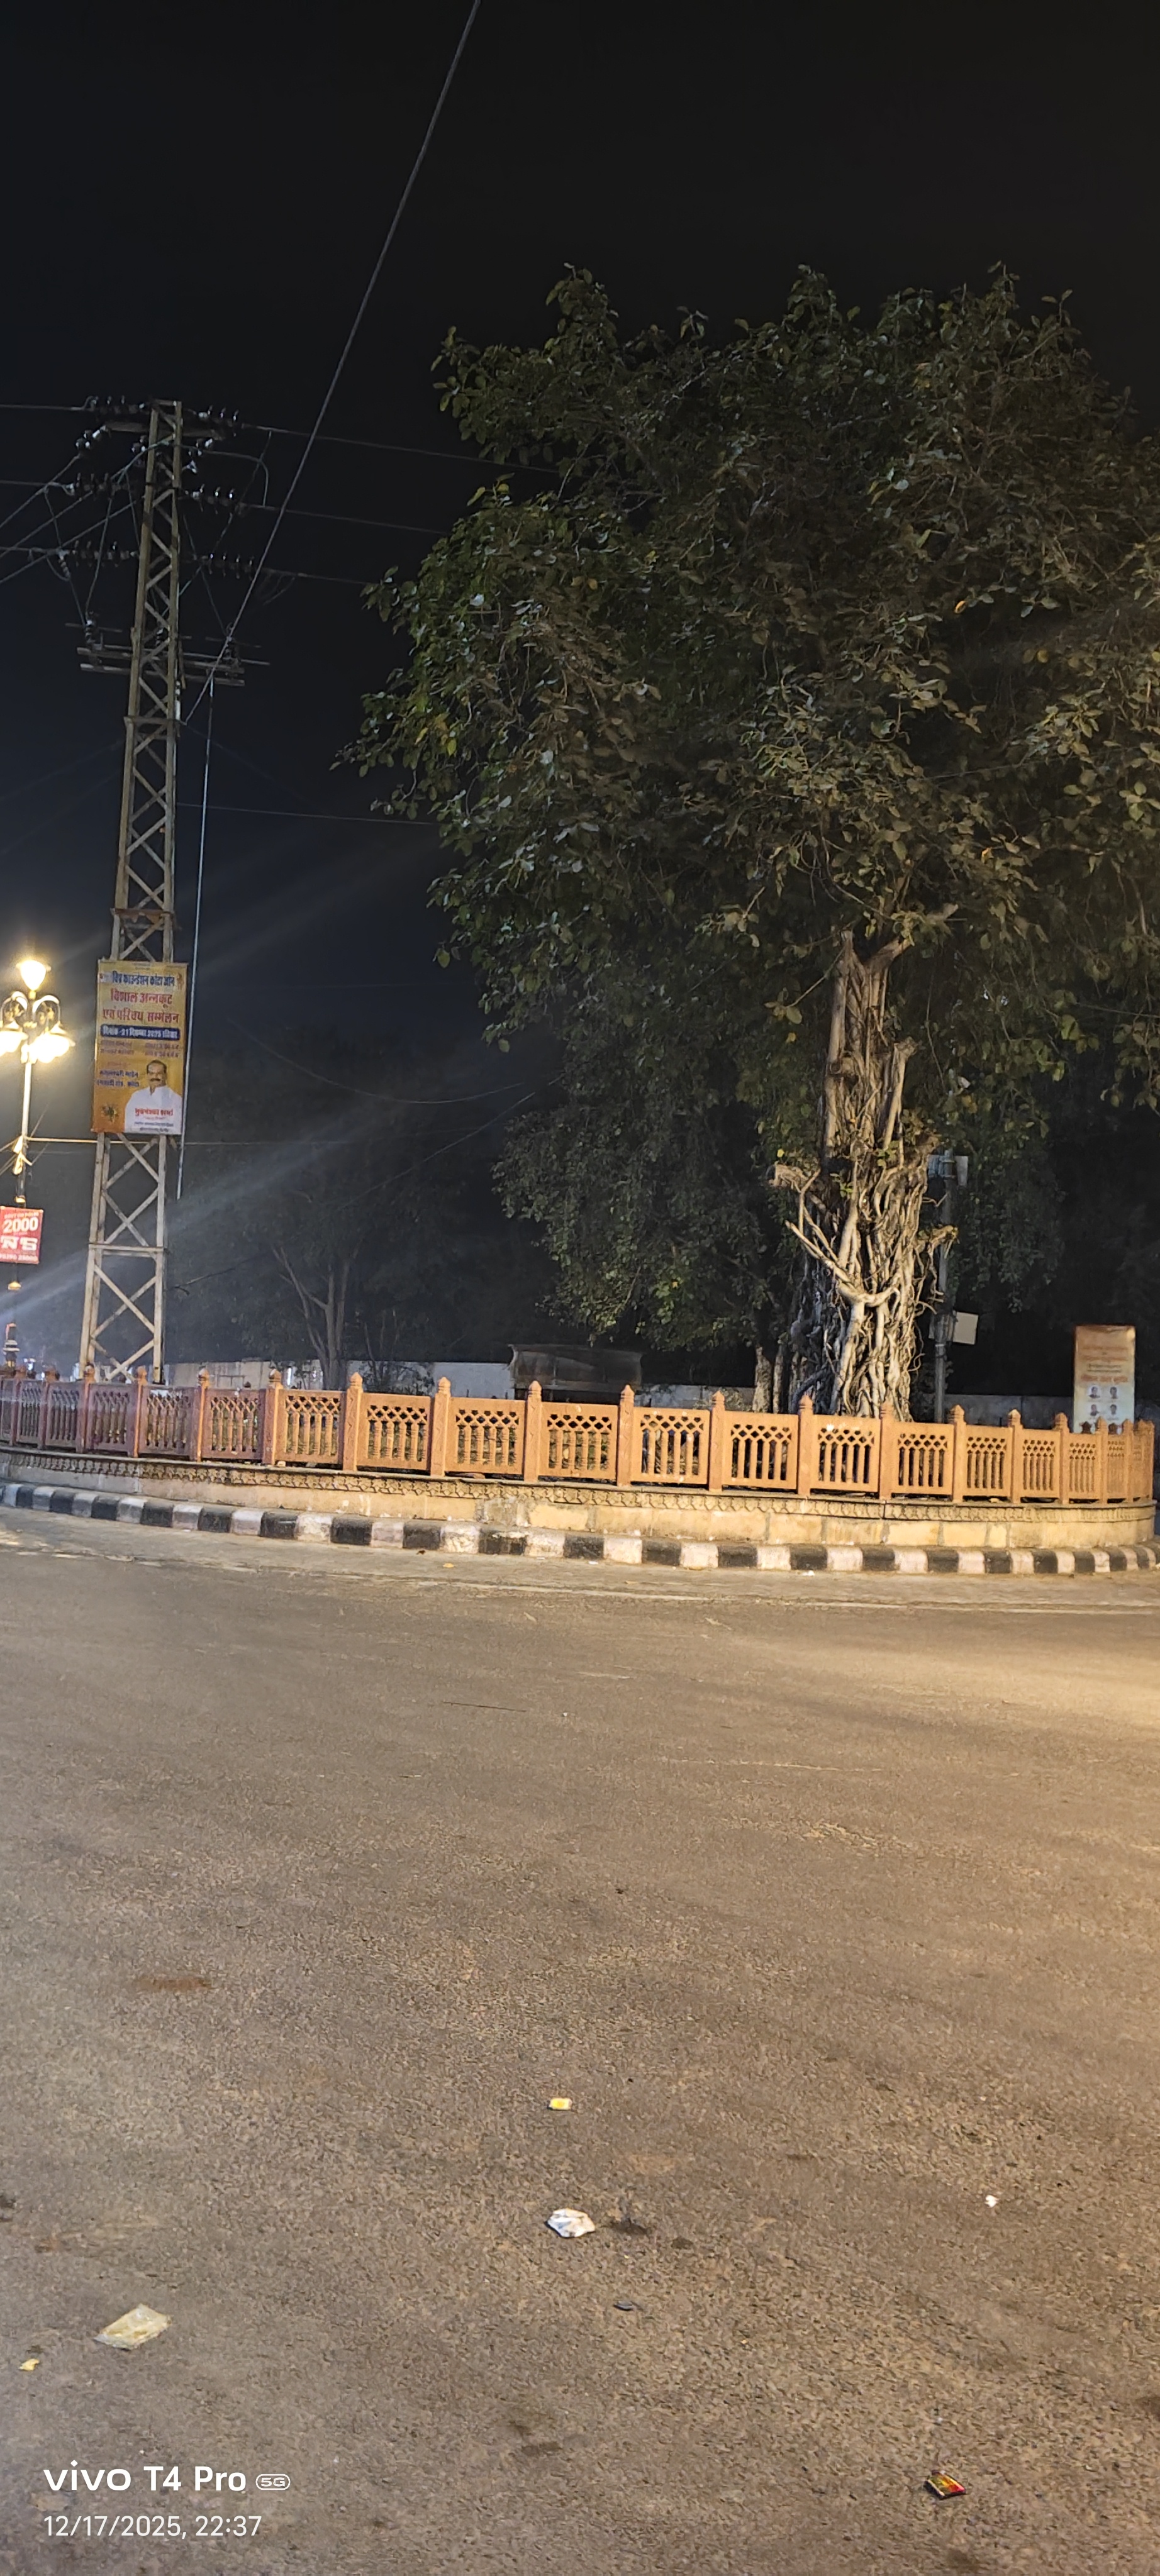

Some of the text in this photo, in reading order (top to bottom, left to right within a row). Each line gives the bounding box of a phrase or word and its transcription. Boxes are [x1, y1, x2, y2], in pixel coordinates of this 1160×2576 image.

[140, 992, 172, 1009] अन्नकूट
[147, 1011, 179, 1023] सम्मेलन
[3, 1217, 38, 1233] 2000
